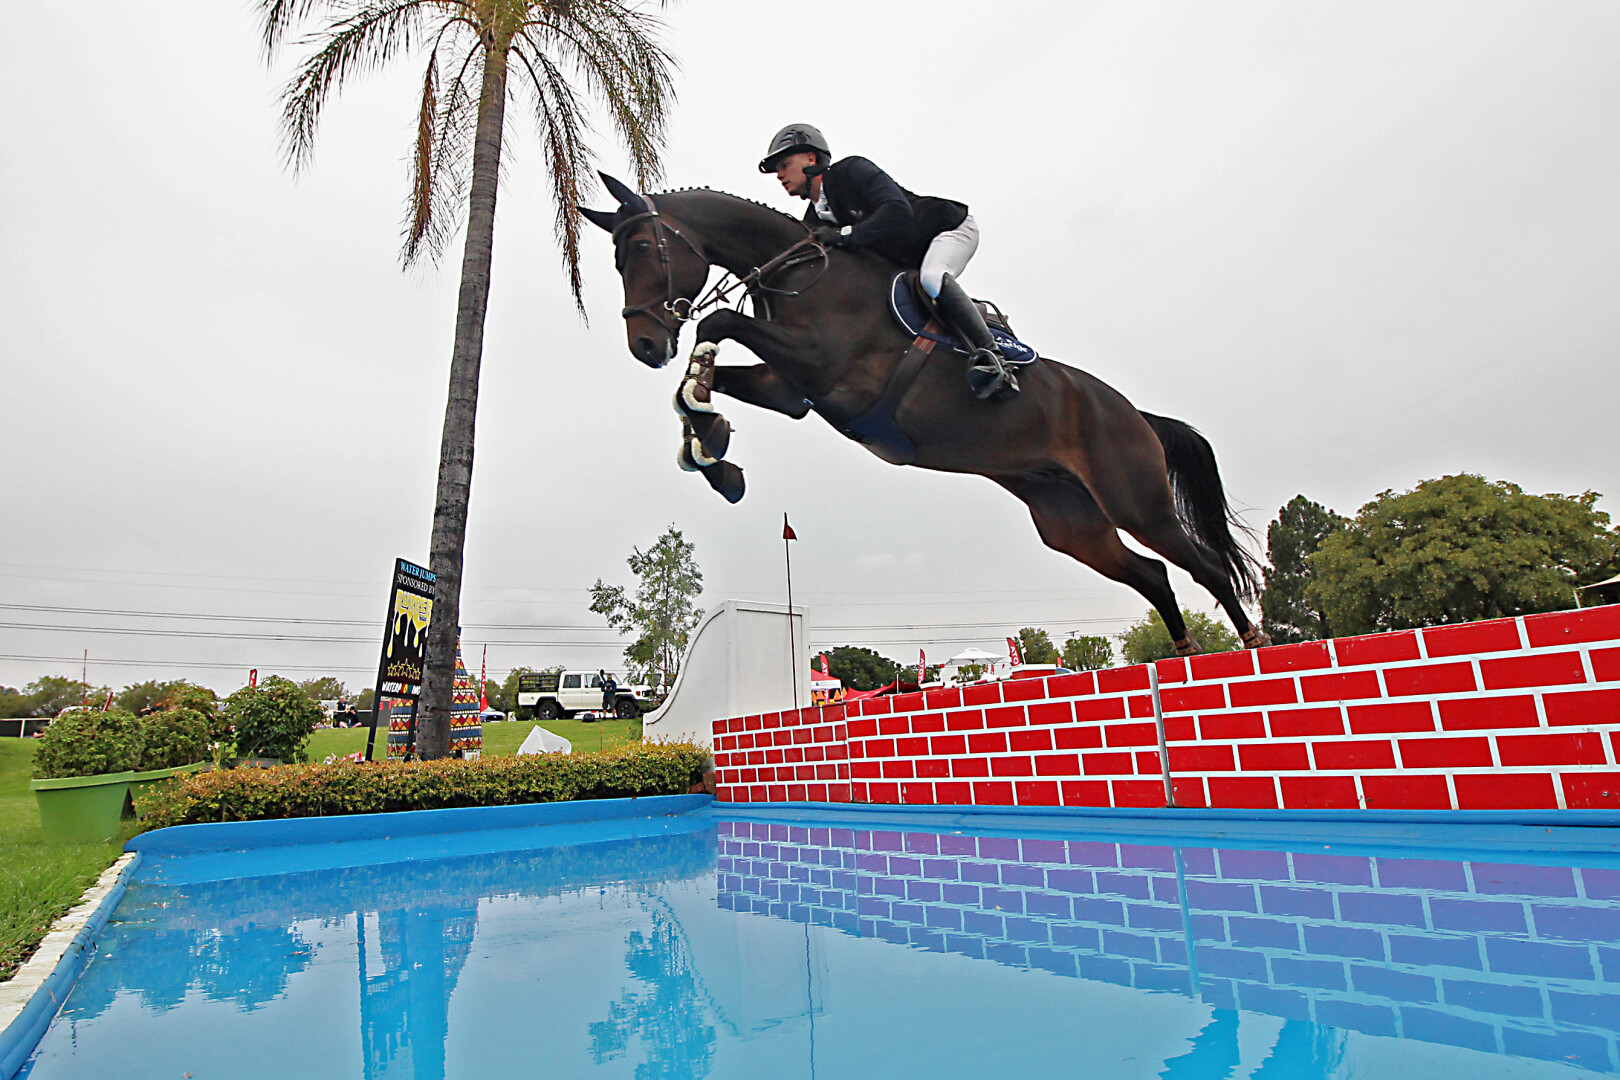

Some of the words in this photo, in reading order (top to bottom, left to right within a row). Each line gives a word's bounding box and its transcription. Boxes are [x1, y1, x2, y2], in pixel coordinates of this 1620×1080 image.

[401, 561, 419, 577] WATER
[419, 569, 437, 583] JUMPS
[397, 574, 428, 592] SPONSORED
[428, 585, 435, 594] BY
